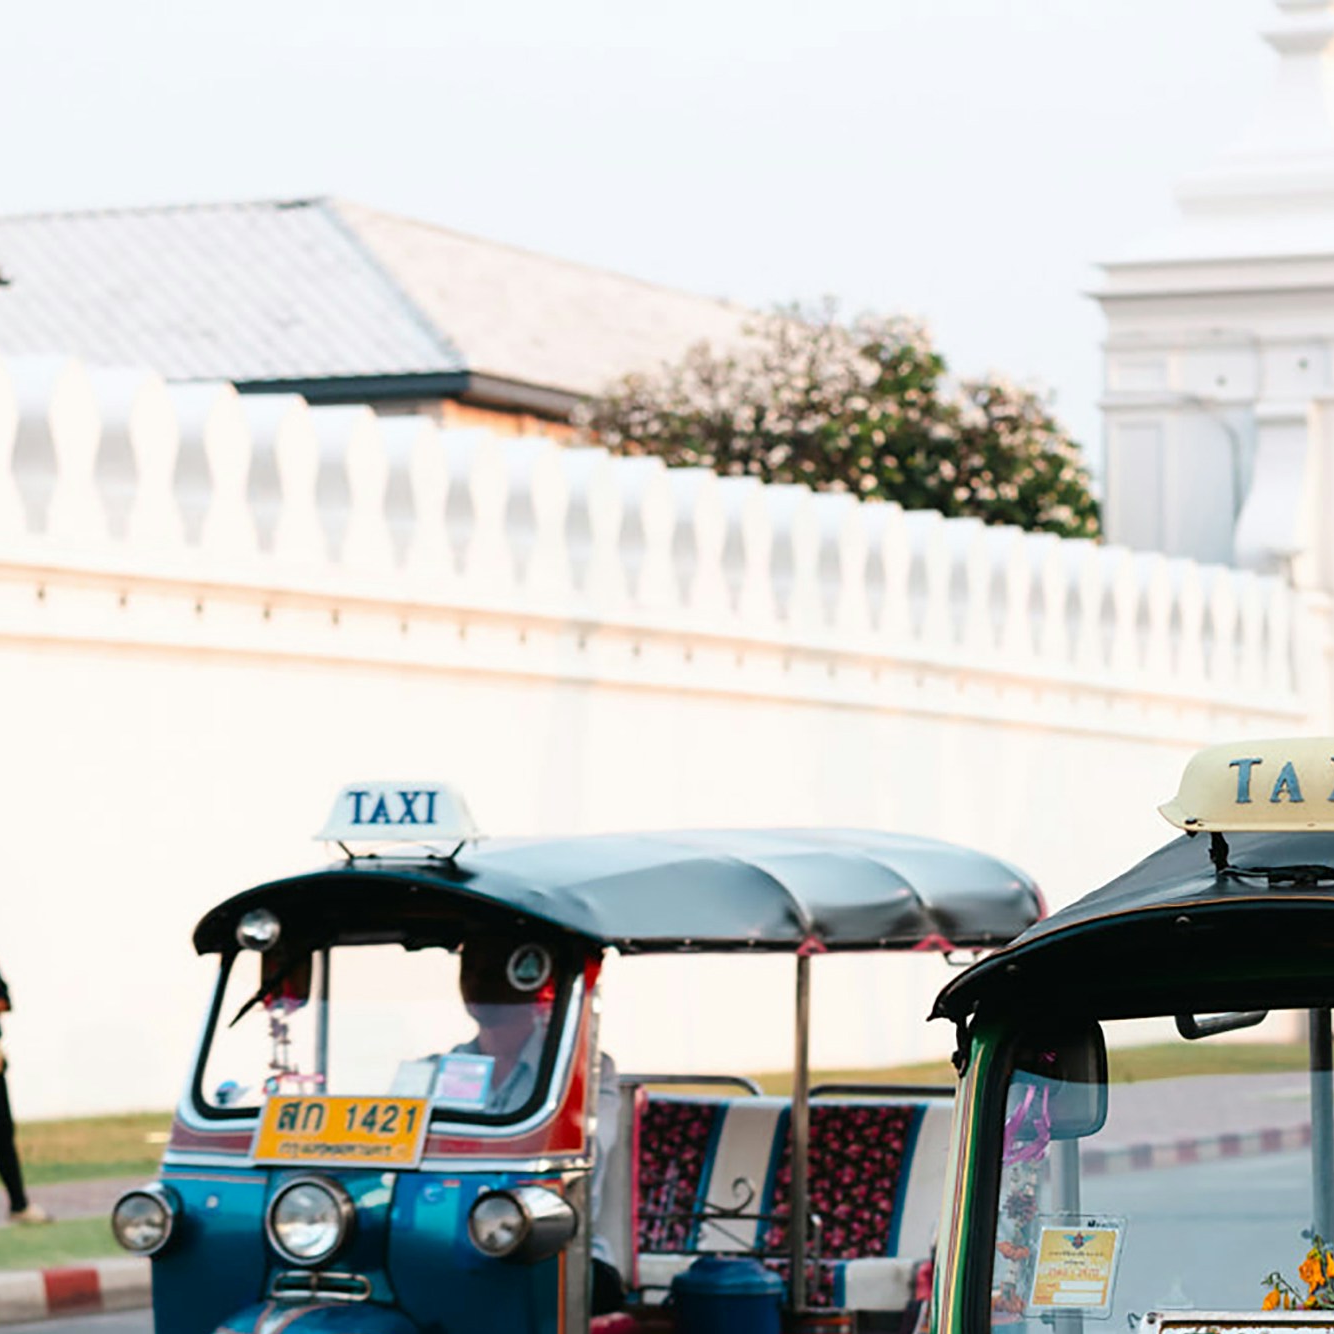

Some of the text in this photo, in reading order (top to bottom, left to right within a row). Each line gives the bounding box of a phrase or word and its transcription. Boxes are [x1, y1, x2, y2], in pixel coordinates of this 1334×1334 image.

[346, 790, 439, 825] TAXI
[277, 1101, 417, 1134] สก 1421
